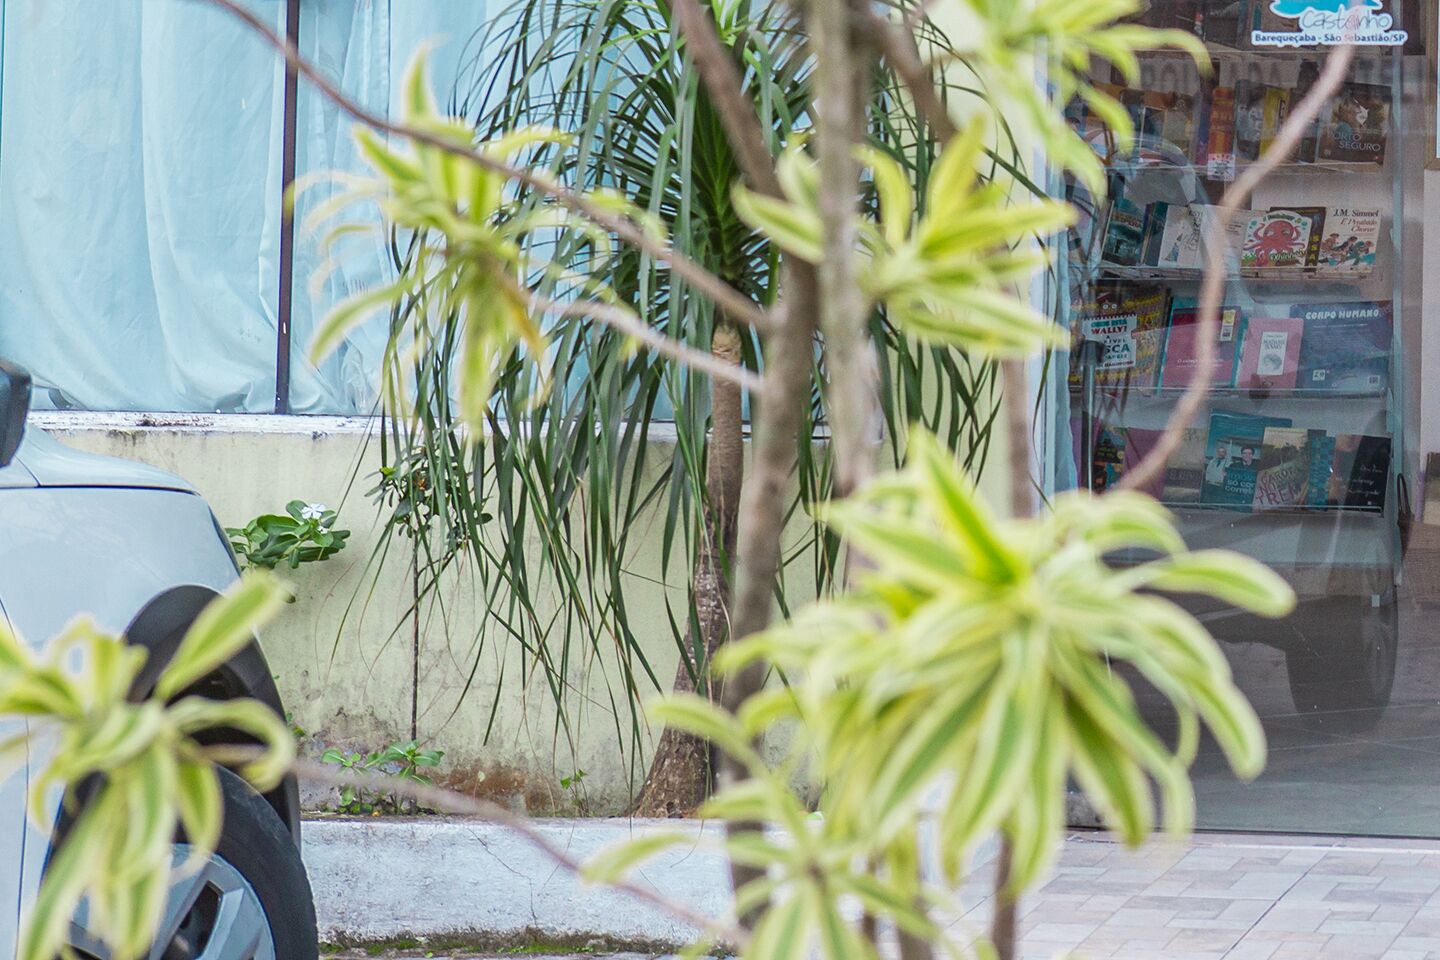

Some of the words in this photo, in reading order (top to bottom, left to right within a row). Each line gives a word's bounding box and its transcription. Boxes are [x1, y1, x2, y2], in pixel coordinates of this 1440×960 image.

[1255, 32, 1316, 44] Barequeçaba
[1339, 140, 1381, 152] SEGURO
[1305, 311, 1337, 320] CORPO
[1339, 309, 1379, 319] HUMANO
[1091, 326, 1127, 334] WALLY?
